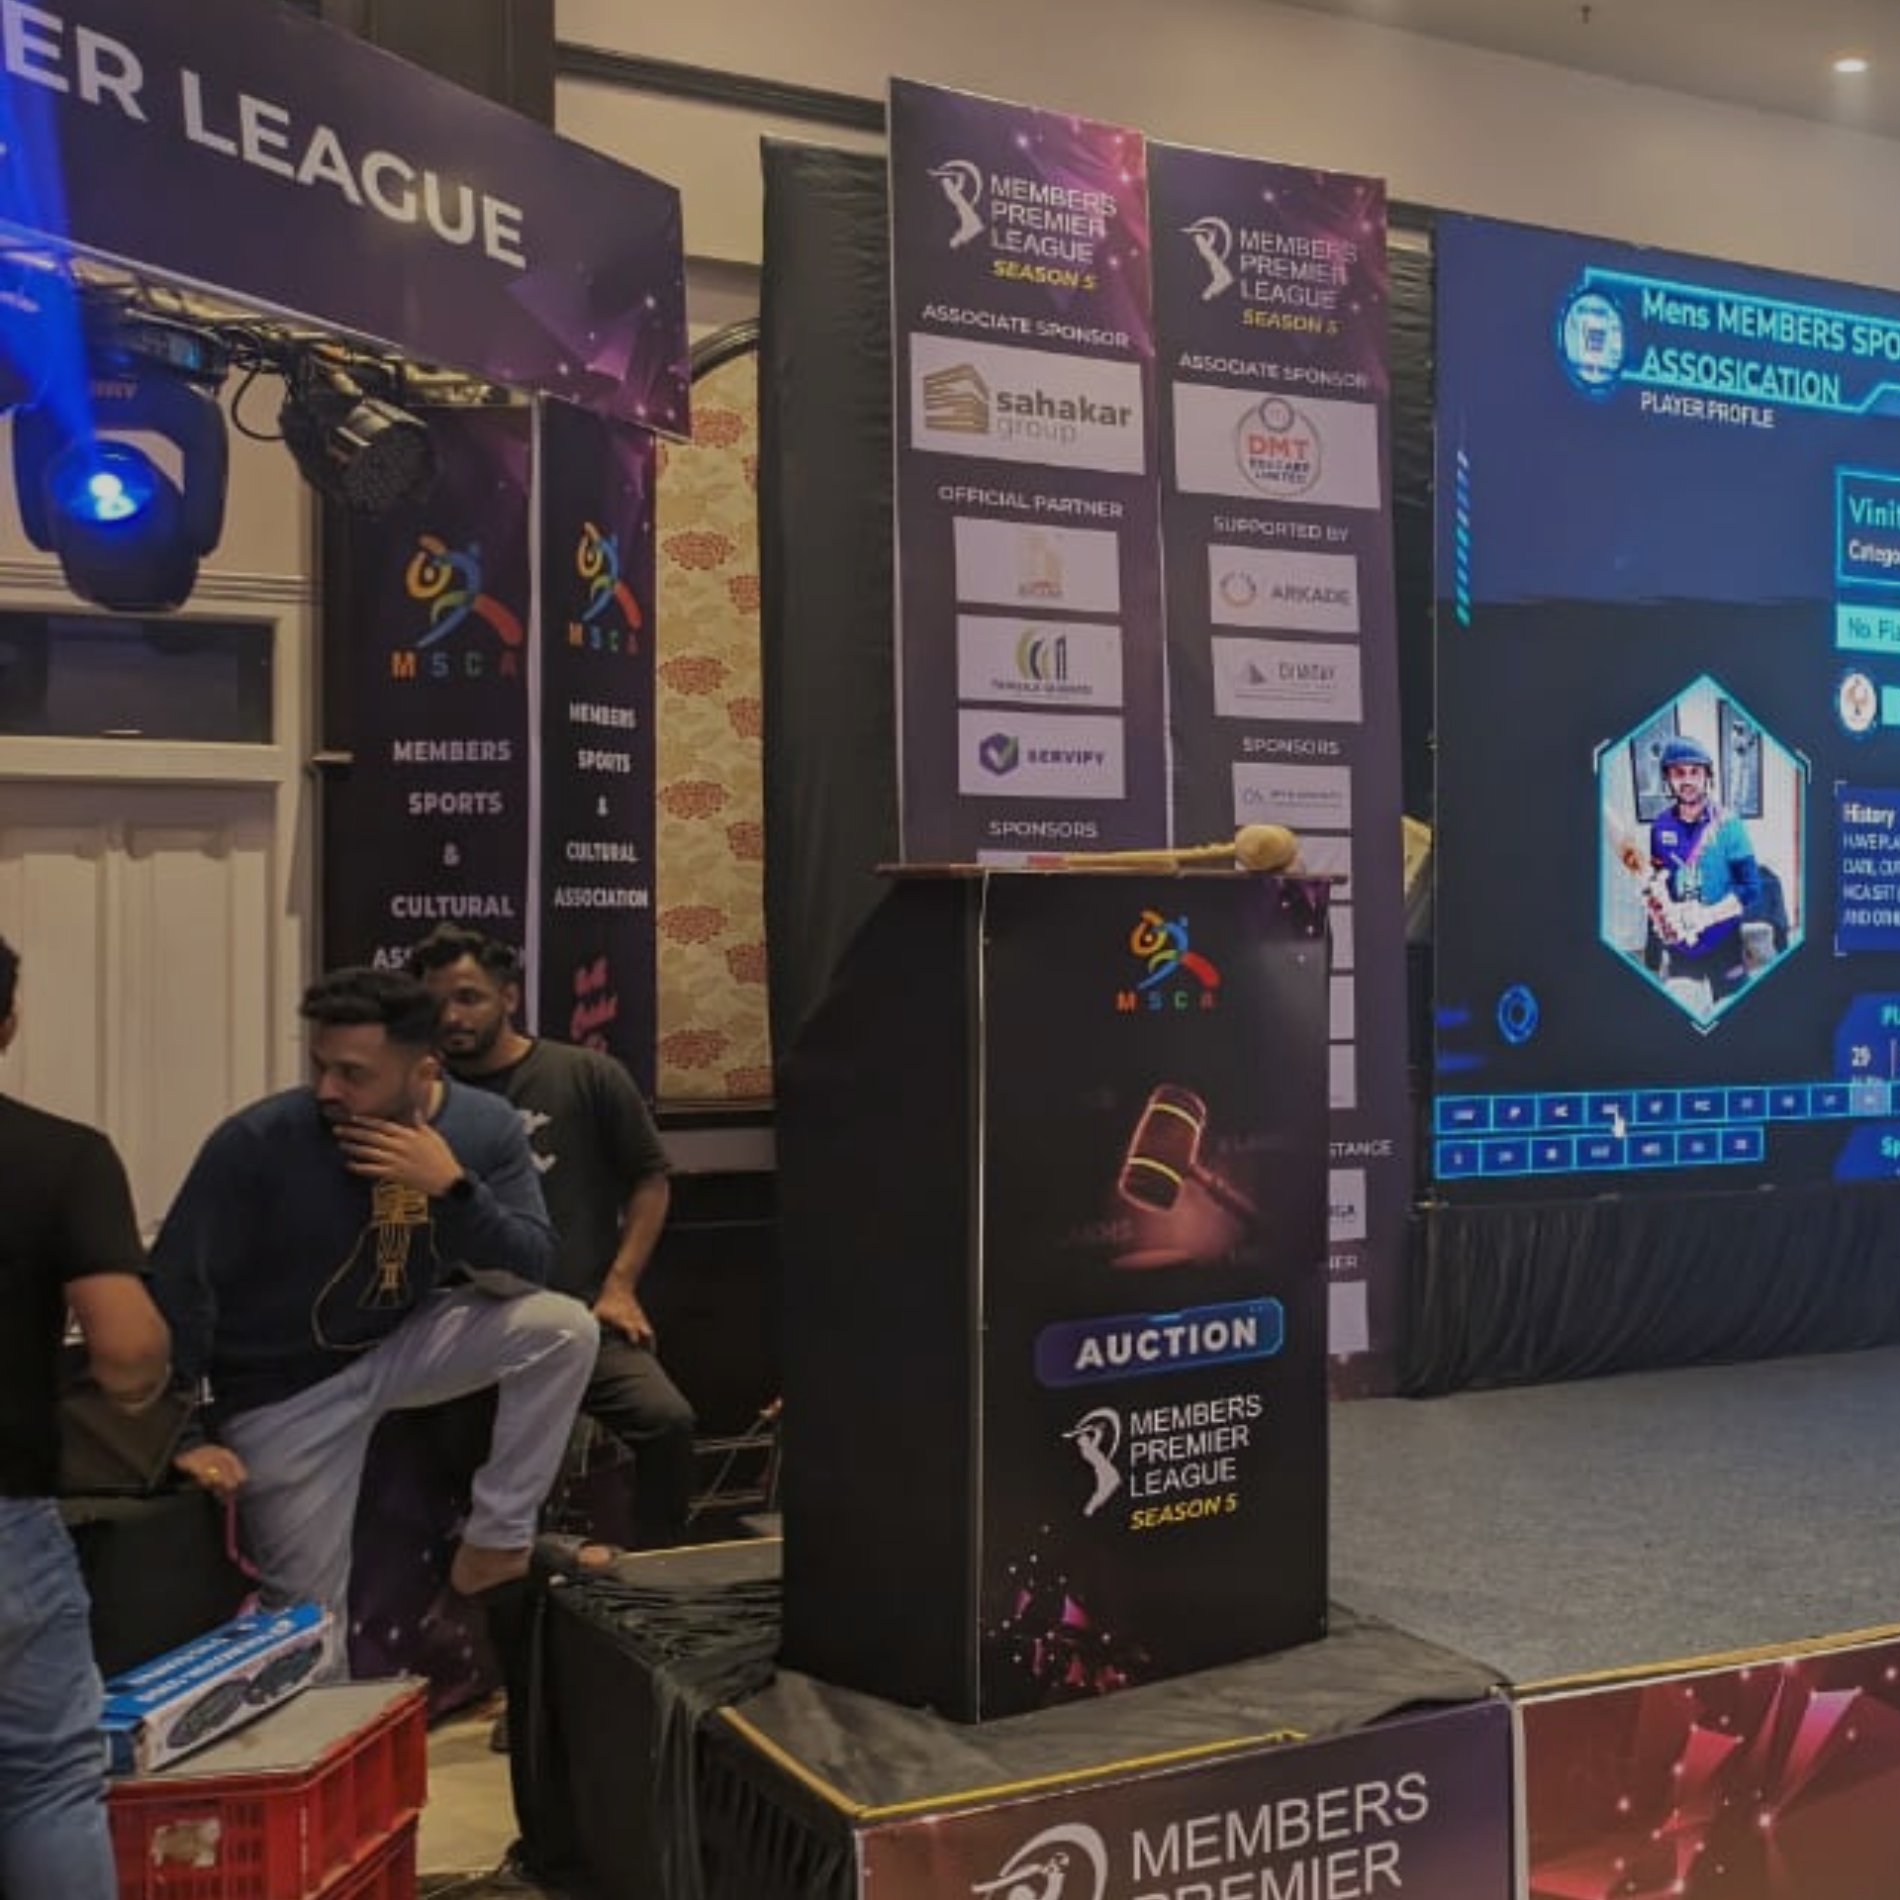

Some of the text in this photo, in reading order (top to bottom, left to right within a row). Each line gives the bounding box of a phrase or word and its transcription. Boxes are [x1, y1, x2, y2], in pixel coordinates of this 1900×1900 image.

[183, 69, 527, 269] LEAGUE
[992, 175, 1117, 216] MEMBERS
[992, 202, 1107, 238] PREMIER
[992, 230, 1095, 264] LEAGUE
[1239, 229, 1357, 263] MEMBERS
[993, 259, 1096, 290] SEASON 5
[1239, 255, 1348, 286] PREMIER
[1240, 280, 1337, 310] LEAGUE
[922, 303, 1131, 349] ASSOCIATE SPONSOR
[1242, 309, 1321, 333] SEASON
[1641, 288, 1711, 331] Mens
[1717, 304, 1846, 353] MEMBERS
[1178, 352, 1368, 388] ASSOCIATE SPONSOR
[1641, 346, 1841, 404] ASSOSICATION
[996, 386, 1132, 428] sahakar
[1641, 392, 1776, 428] PLAYER PROFILE
[997, 418, 1079, 445] group
[1248, 434, 1309, 460] DMT
[938, 485, 1123, 519] OFFICIAL PARTNER
[1213, 515, 1349, 542] SUPPORTED BY
[1271, 583, 1351, 606] ARKADE
[568, 621, 639, 655] MSCA
[391, 651, 520, 679] MSCA
[568, 703, 636, 728] MEMBERS
[392, 739, 512, 763] MEMBERS
[577, 749, 631, 773] SPORTS
[1027, 749, 1105, 766] SERVIFY
[1242, 737, 1341, 756] SPONSORS
[408, 792, 503, 816] SPORTS
[596, 795, 608, 816] &
[1842, 802, 1896, 830] History
[988, 821, 1099, 839] SPONSORS
[443, 843, 460, 865] &
[565, 840, 637, 863] CULTURAL
[390, 895, 514, 919] CULTURAL
[554, 885, 649, 909] ASSOCIATION
[1116, 990, 1214, 1012] MSCA
[1074, 1316, 1258, 1370] AUCTION
[1129, 1394, 1264, 1436] MEMBERS
[1129, 1424, 1251, 1466] PREMIER
[1129, 1456, 1238, 1498] LEAGUE
[1129, 1492, 1240, 1531] SEASON 5
[1131, 1772, 1430, 1882] MEMBERS
[1131, 1839, 1404, 1900] MIER
